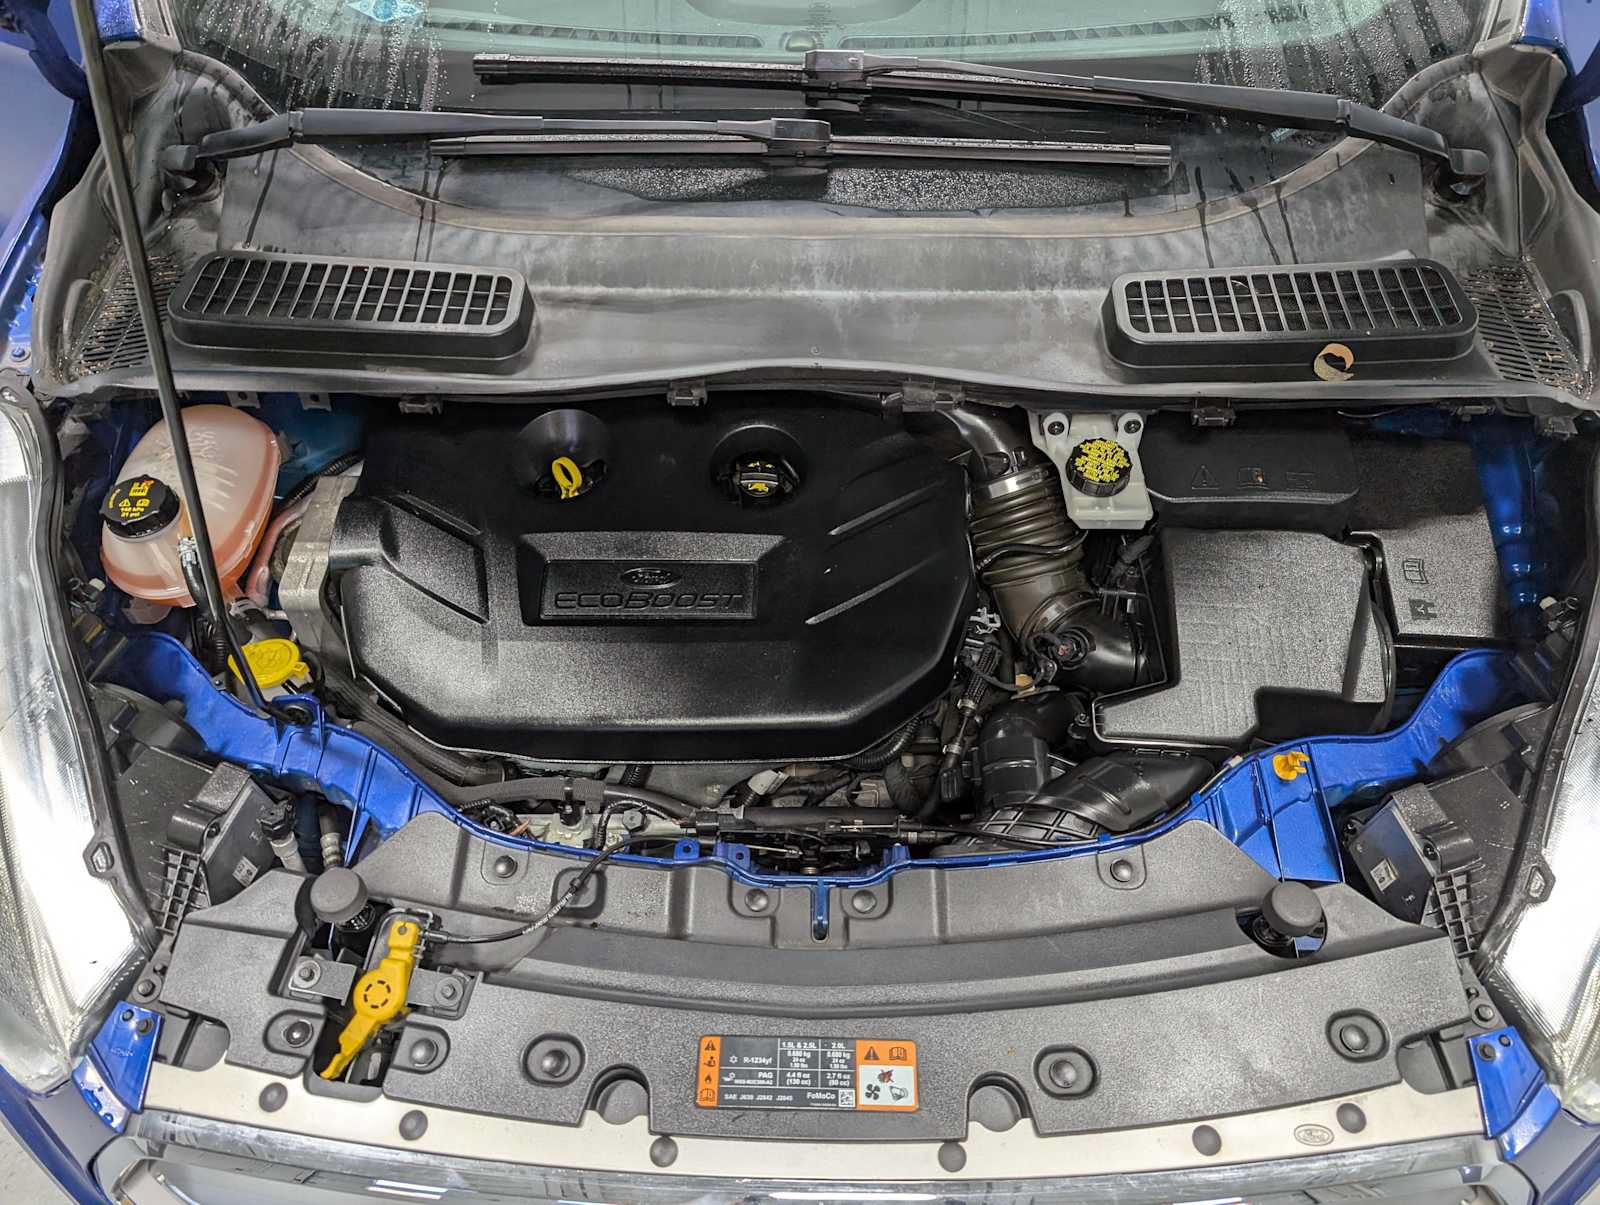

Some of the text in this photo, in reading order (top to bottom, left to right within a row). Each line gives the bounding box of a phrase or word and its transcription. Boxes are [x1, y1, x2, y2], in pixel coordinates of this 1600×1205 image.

[555, 592, 743, 609] ECOBOOST
[743, 1056, 772, 1065] R-1234yf
[758, 1071, 773, 1079] PAG
[806, 1092, 836, 1100] FoMoCo
